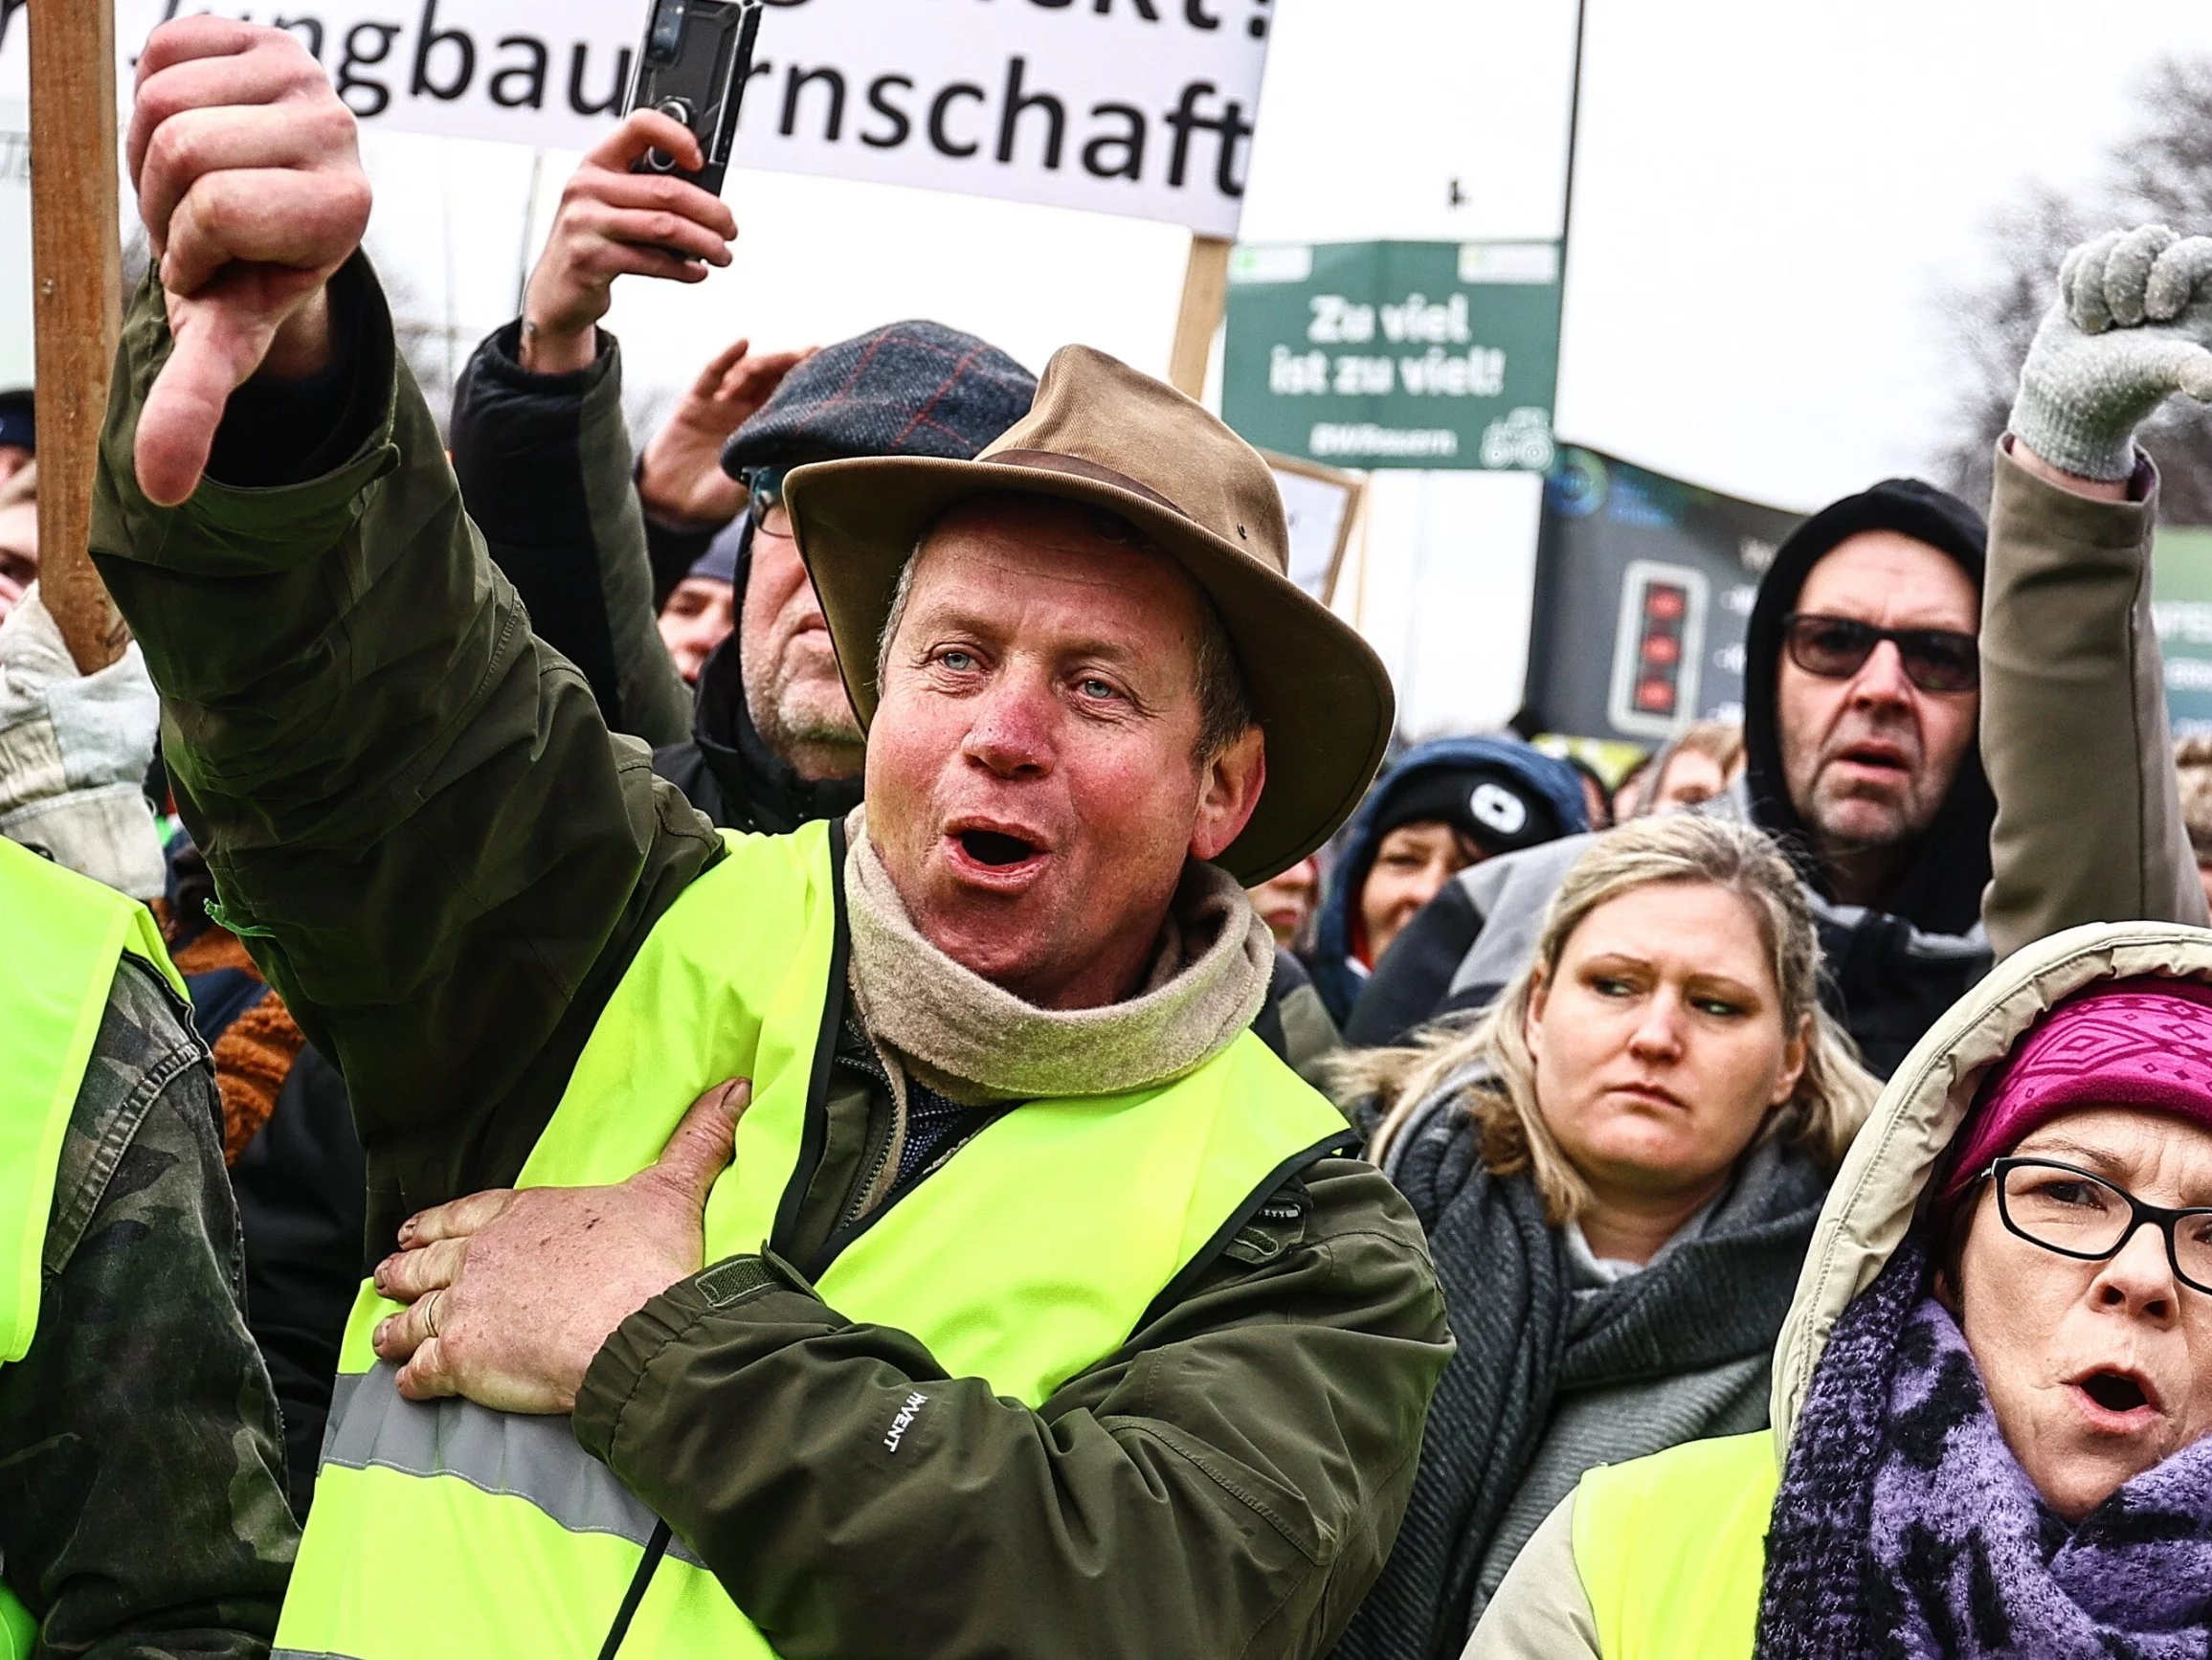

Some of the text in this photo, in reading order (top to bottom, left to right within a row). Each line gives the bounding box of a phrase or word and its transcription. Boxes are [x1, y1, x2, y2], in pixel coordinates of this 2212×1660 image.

[1309, 293, 1470, 343] Zu viel
[1270, 346, 1505, 396] ist zu viel!
[883, 1391, 928, 1452] HYVENT
